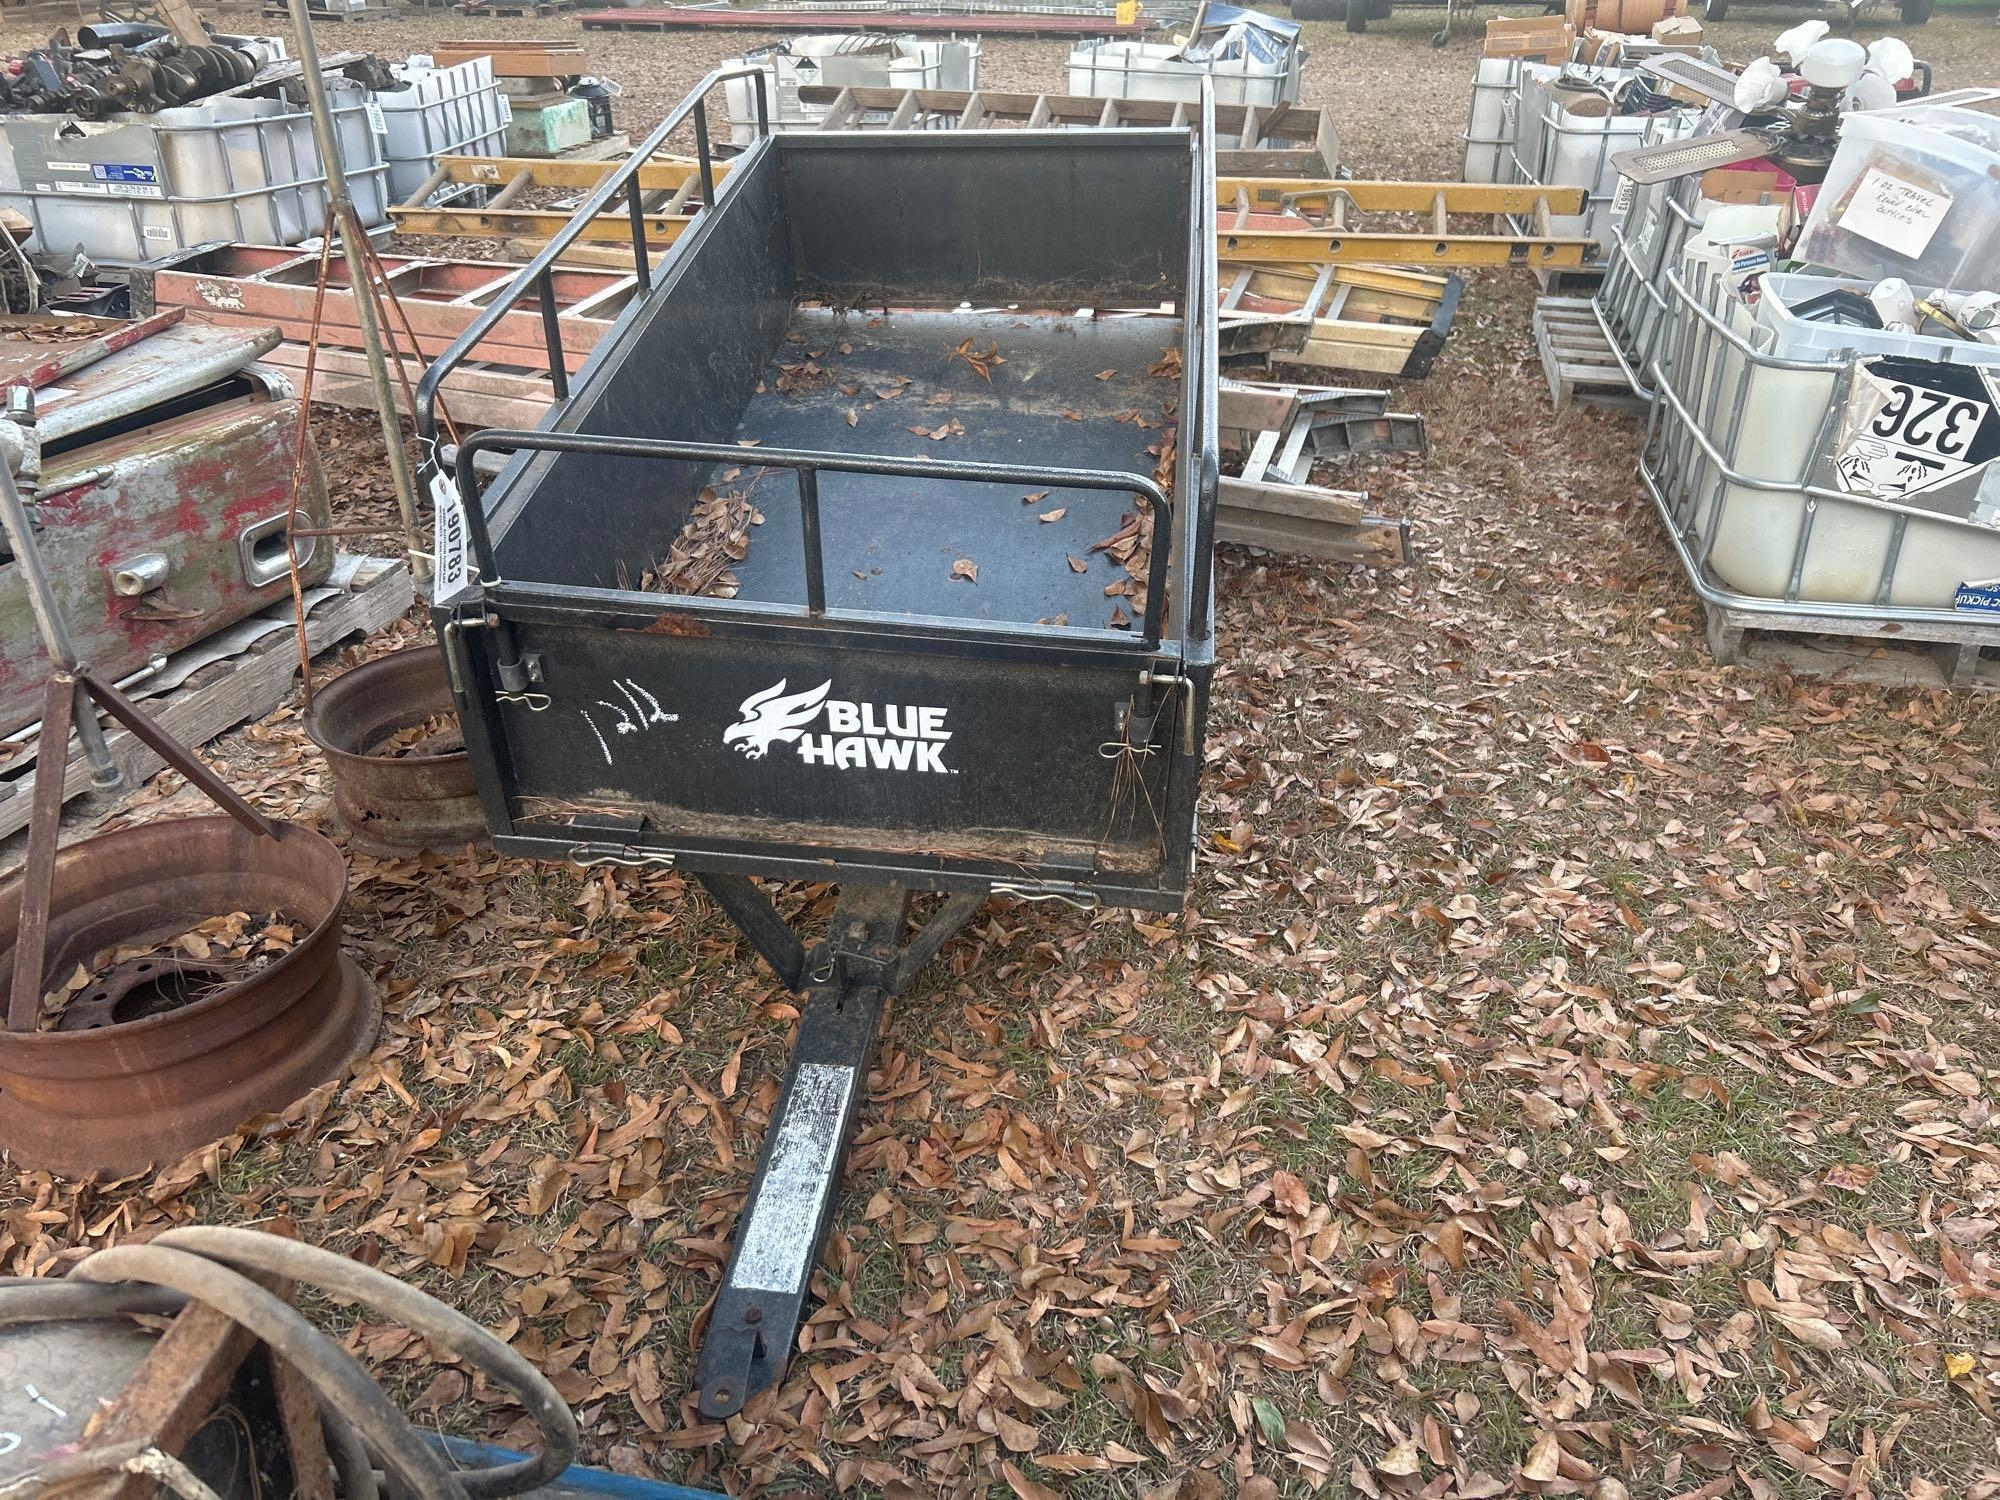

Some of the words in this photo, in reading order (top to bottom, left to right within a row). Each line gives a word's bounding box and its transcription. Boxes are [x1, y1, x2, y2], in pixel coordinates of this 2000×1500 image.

[1618, 184, 1633, 211] 190613
[447, 500, 462, 584] 190783
[825, 700, 953, 740] BLUE
[797, 733, 949, 774] HAWK
